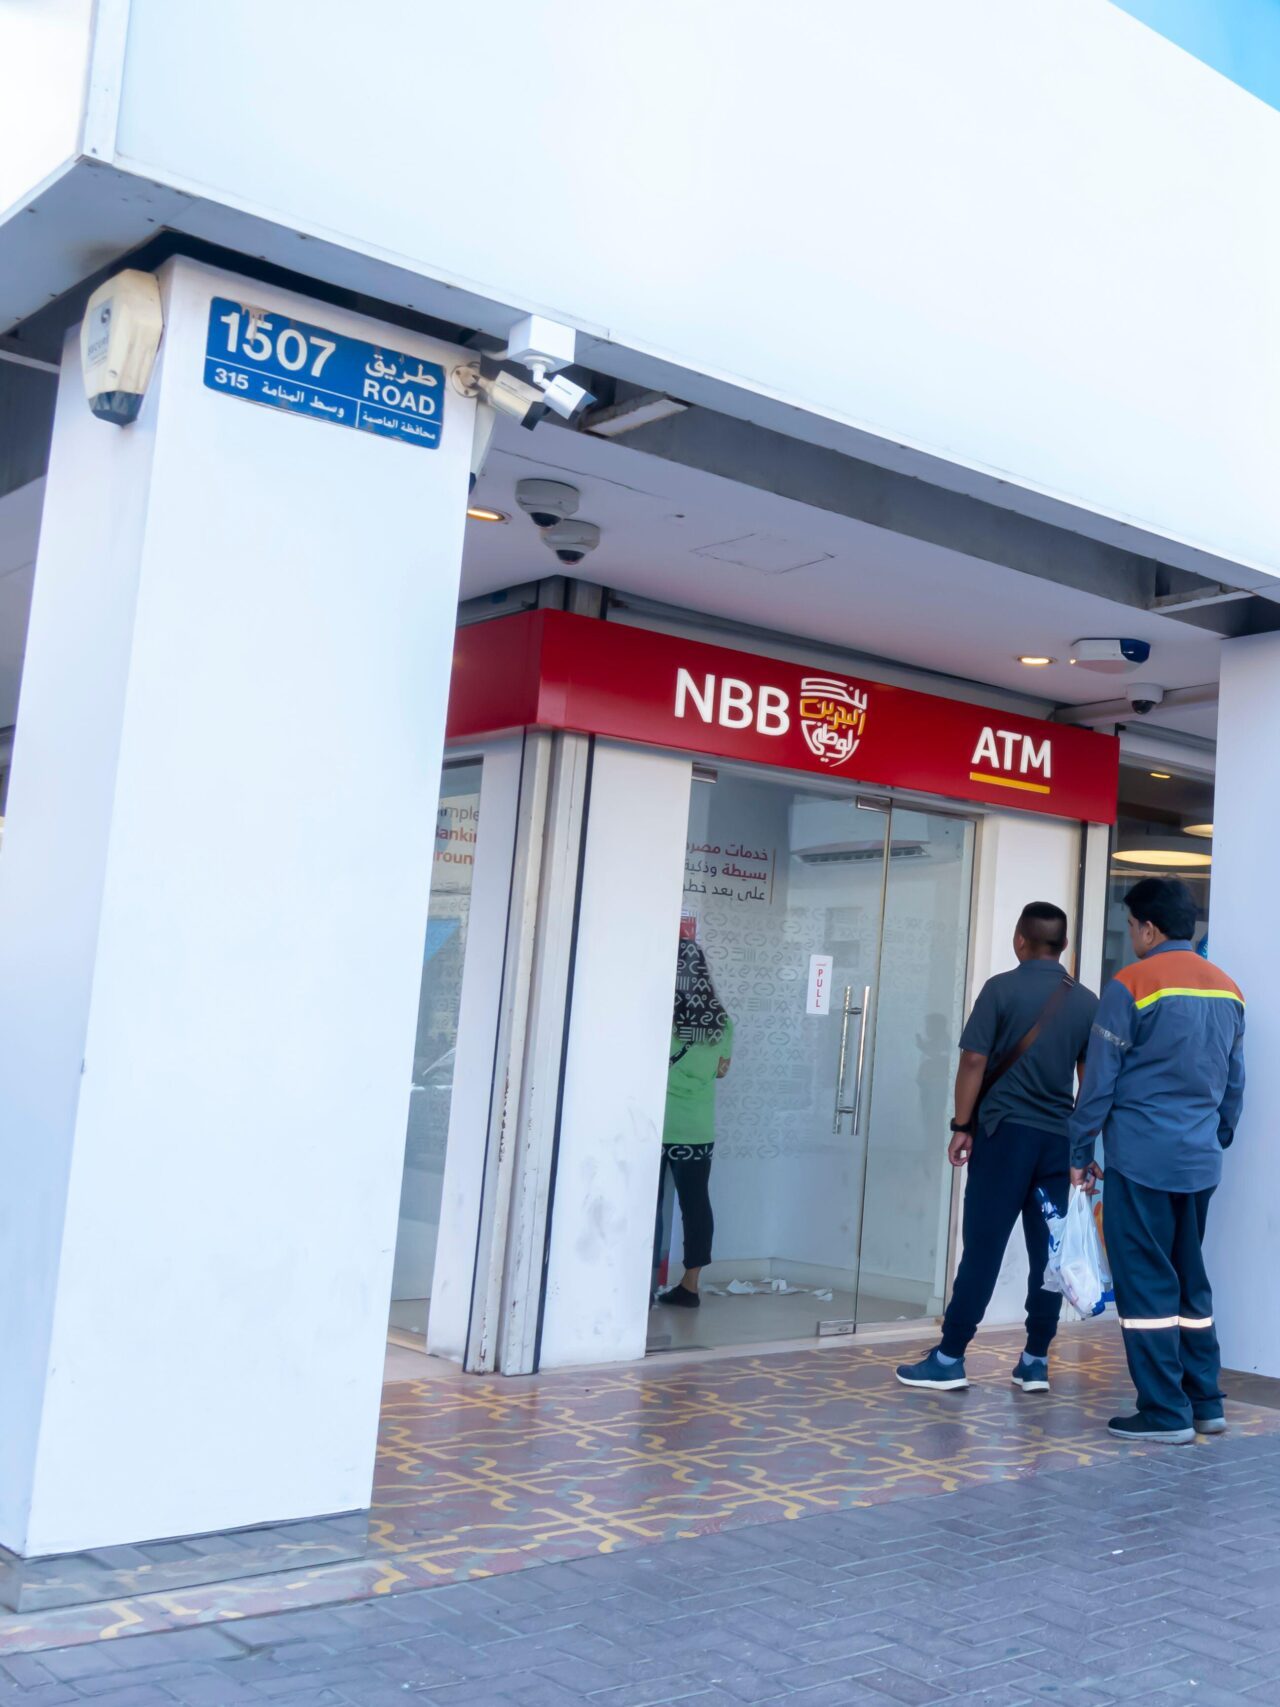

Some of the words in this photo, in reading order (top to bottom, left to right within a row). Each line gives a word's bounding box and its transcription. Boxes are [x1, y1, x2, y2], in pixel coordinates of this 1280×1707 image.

[220, 312, 336, 377] 1507
[214, 367, 249, 390] 315
[365, 354, 438, 387] طريق
[262, 381, 304, 403] المنامة
[363, 379, 435, 415] ROAD
[309, 396, 345, 418] وسط
[362, 411, 398, 429] العاصمة
[400, 421, 436, 440] محافظة
[674, 668, 790, 736] NBB
[800, 698, 866, 736] البحرين
[971, 726, 1052, 778] ATM
[438, 801, 479, 822] imple
[725, 844, 768, 861] خدمات
[721, 863, 767, 884] بسيطة
[711, 886, 733, 901] بعد
[737, 886, 765, 901] على
[815, 968, 824, 1008] PULL
